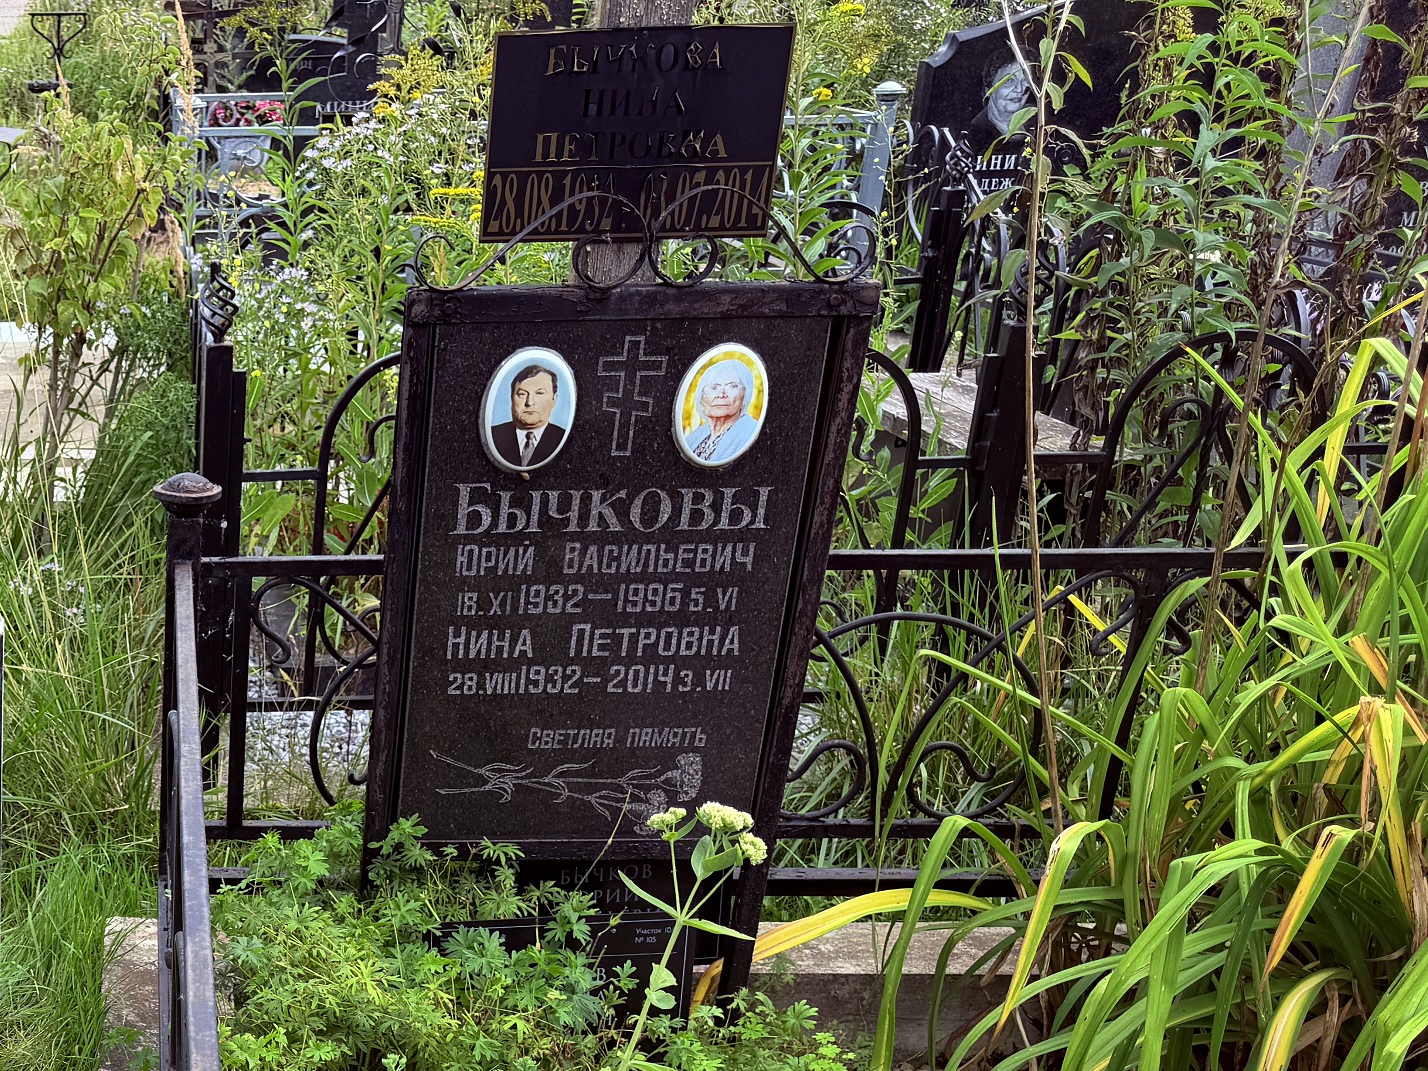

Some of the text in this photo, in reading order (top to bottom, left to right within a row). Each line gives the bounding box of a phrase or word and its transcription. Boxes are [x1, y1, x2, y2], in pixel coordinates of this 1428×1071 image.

[544, 40, 726, 76] БЫЧКОВА
[582, 84, 686, 118] НИНА
[532, 129, 728, 162] ПЕТРОВНА
[448, 482, 775, 535] БЫЧКОВЫ
[454, 541, 757, 576] ЮРИЙ ВАСИЛЬЕВИЧ
[446, 622, 740, 660] НИНА ПЕТРОВНА
[527, 726, 707, 749] СВЕТЛАЯ ПАМЯТЬ
[560, 863, 653, 885] БЫЧКОВ
[635, 927, 662, 935] Участок
